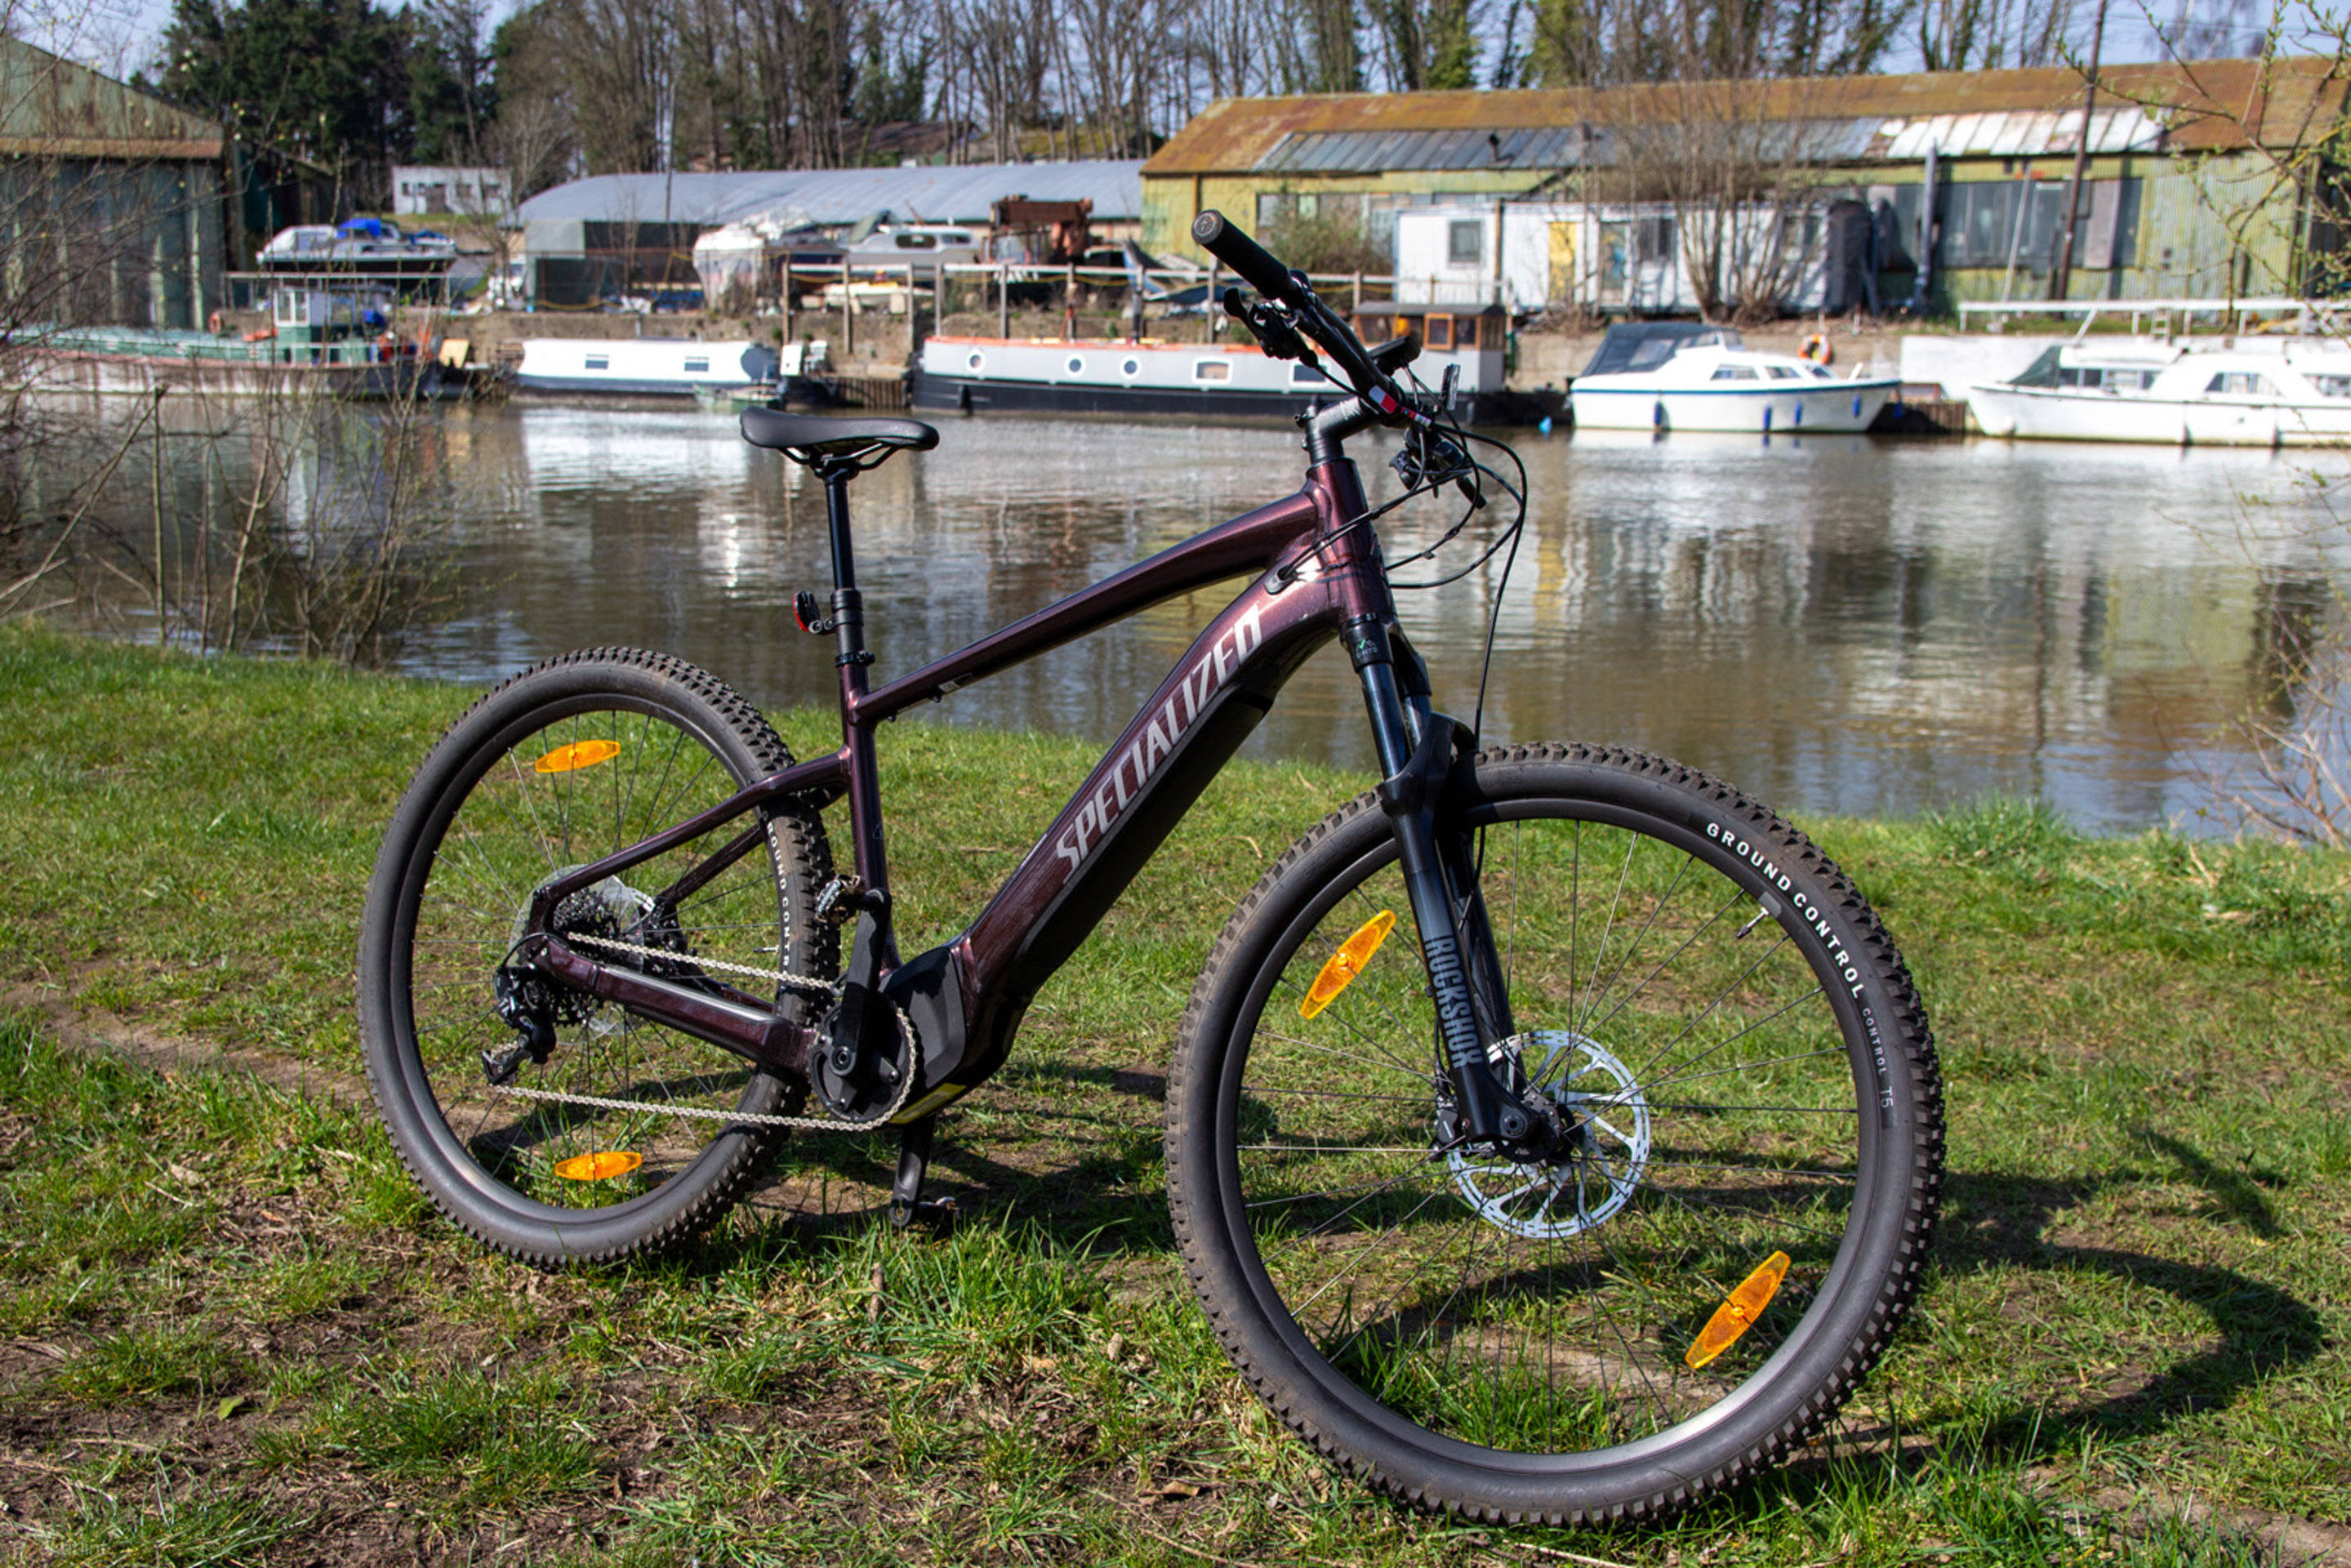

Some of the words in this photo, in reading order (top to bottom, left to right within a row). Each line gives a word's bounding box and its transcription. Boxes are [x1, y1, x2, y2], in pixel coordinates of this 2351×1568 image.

[1057, 601, 1262, 884] SPECIALIZED
[762, 809, 786, 891] GROUND
[1424, 937, 1484, 1069] ROCKSHOX
[1707, 822, 1792, 892] GROUND
[1793, 893, 1863, 999] CONTROL
[1862, 1007, 1887, 1076] CONTROL
